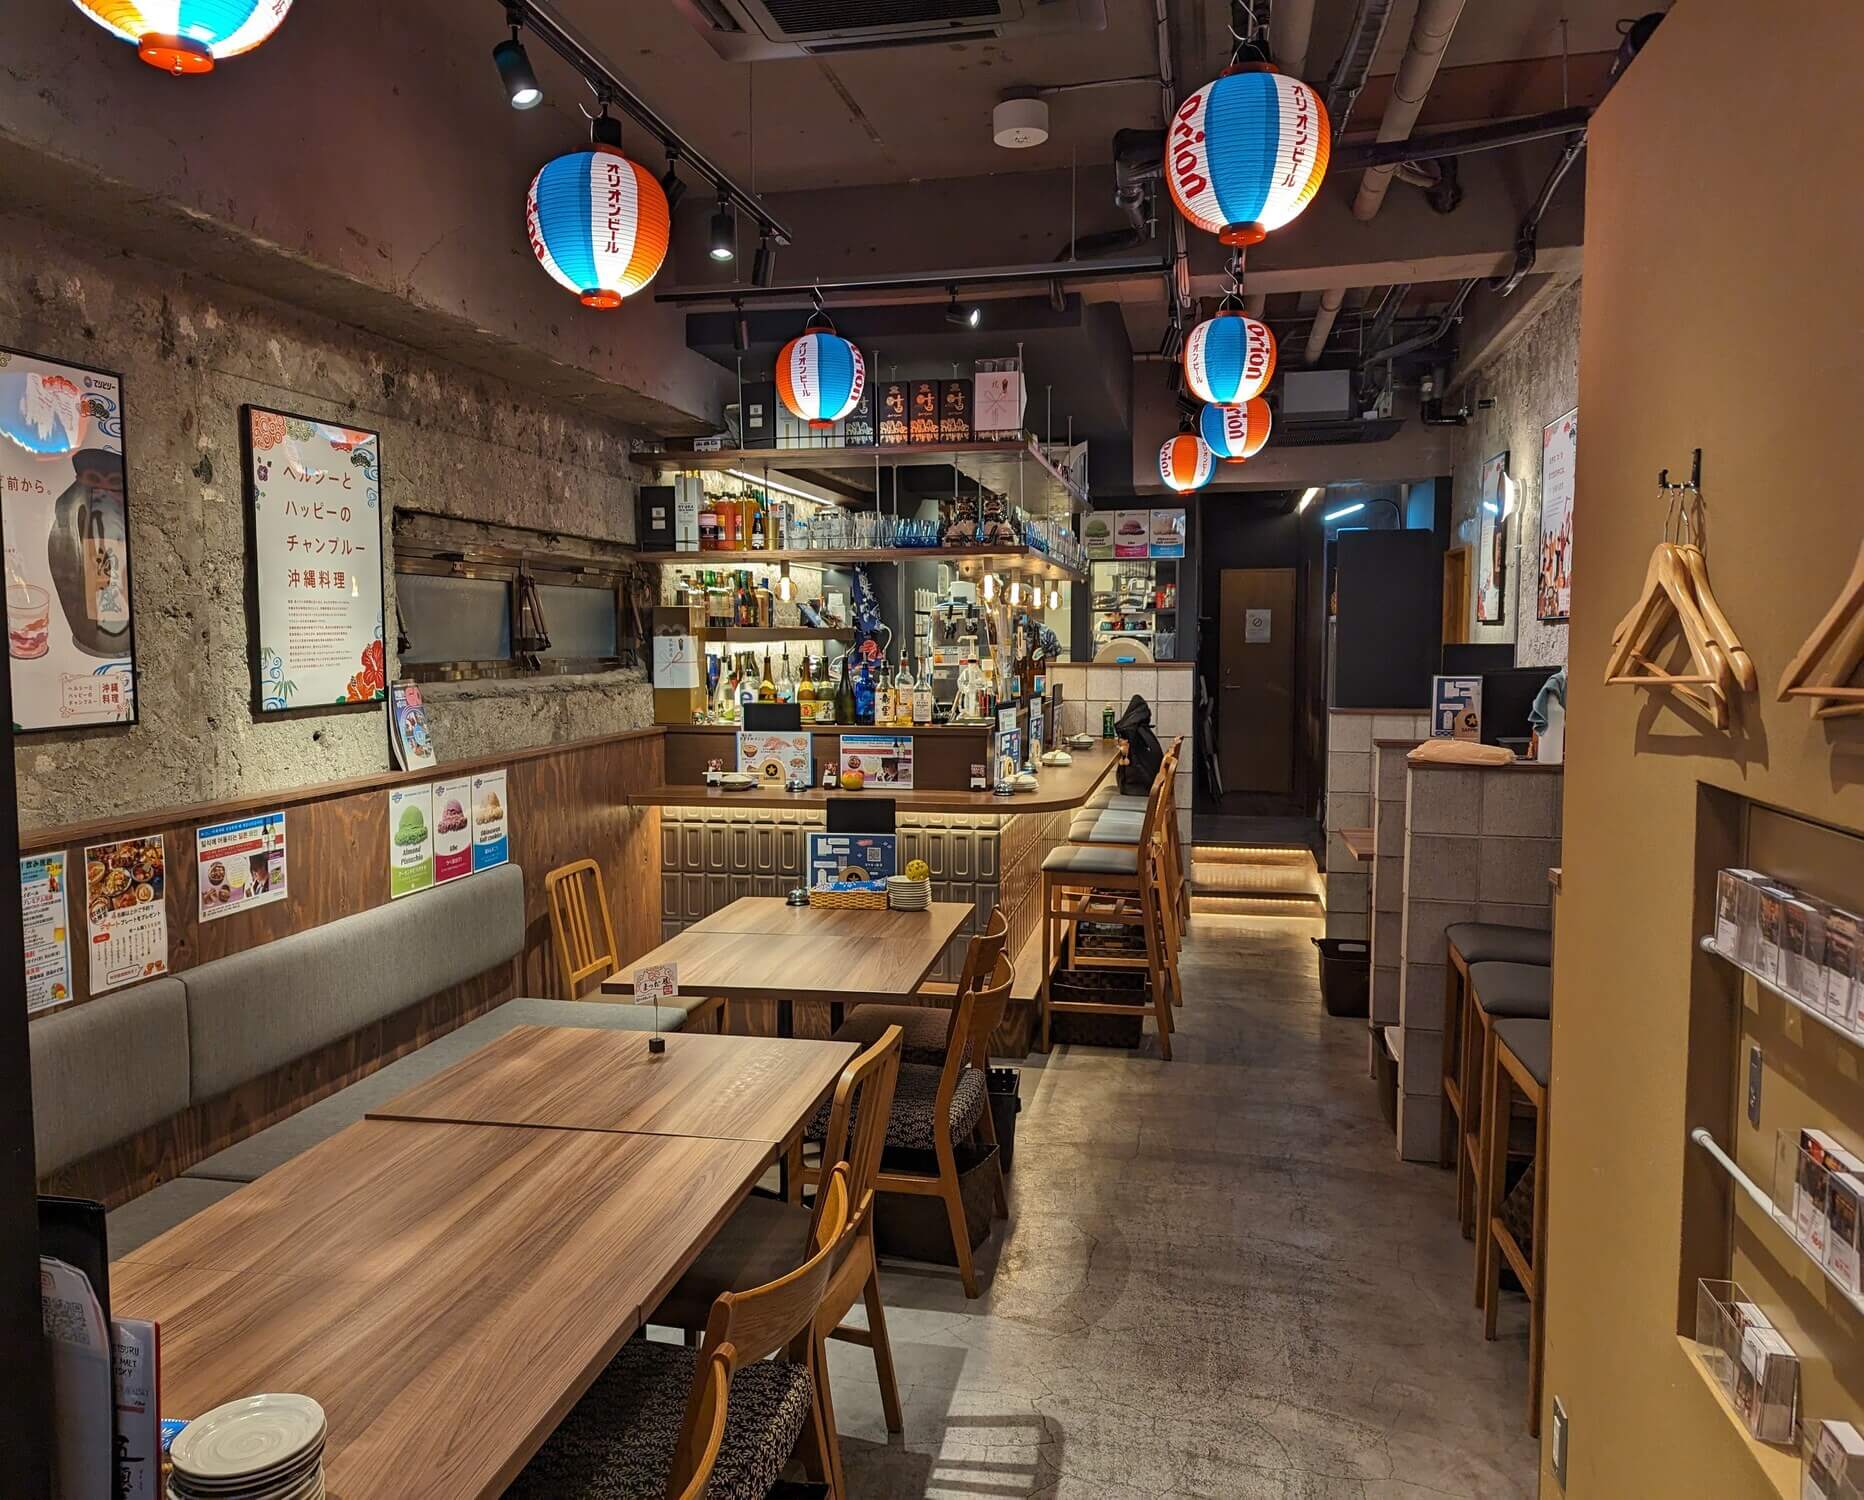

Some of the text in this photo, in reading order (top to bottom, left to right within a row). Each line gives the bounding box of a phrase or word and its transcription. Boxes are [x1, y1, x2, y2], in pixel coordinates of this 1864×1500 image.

[1174, 94, 1207, 199] Orion
[1281, 85, 1308, 188] オリオンビール
[605, 164, 622, 254] オリオンビール
[799, 341, 811, 397] オリオンビール
[1245, 324, 1271, 380] Orion
[1227, 407, 1248, 440] rion
[282, 465, 353, 490] ヘルシーと
[284, 499, 352, 523] ハッピーの
[287, 568, 346, 590] 沖縄料理
